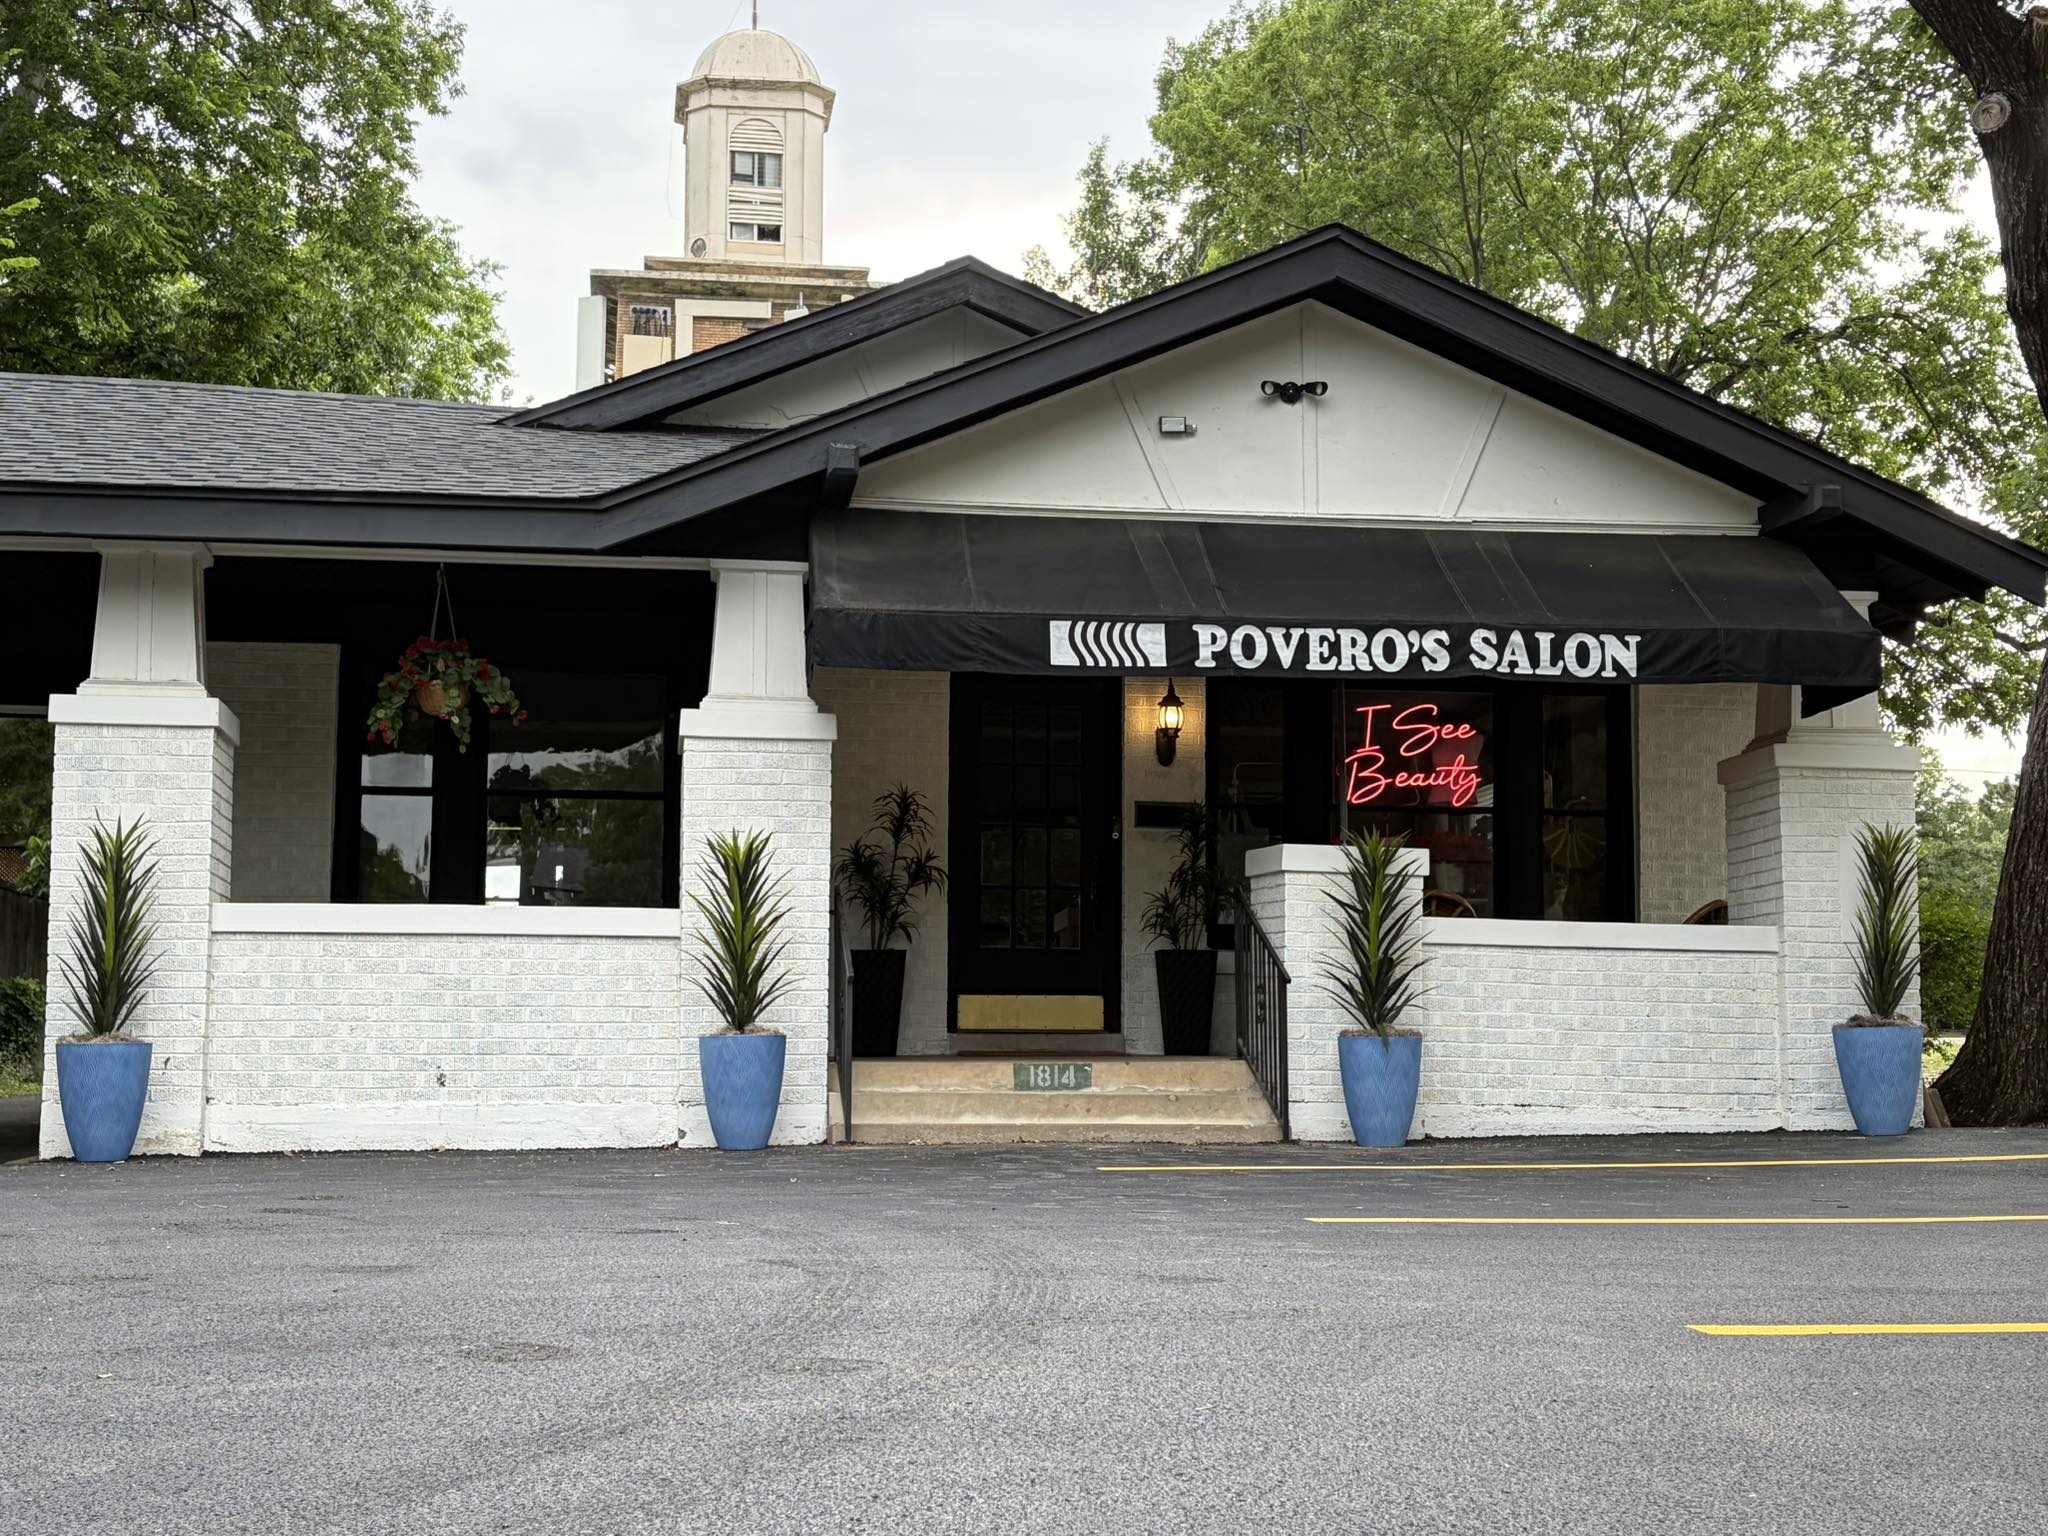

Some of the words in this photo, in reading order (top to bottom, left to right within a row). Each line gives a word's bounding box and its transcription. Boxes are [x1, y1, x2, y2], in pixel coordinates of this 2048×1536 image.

[1191, 622, 1452, 674] POVERO'S
[1467, 628, 1642, 679] SALON
[1356, 704, 1392, 753] I
[1392, 704, 1477, 757] See
[1344, 751, 1482, 807] Beauty
[1027, 1064, 1076, 1088] 1814
